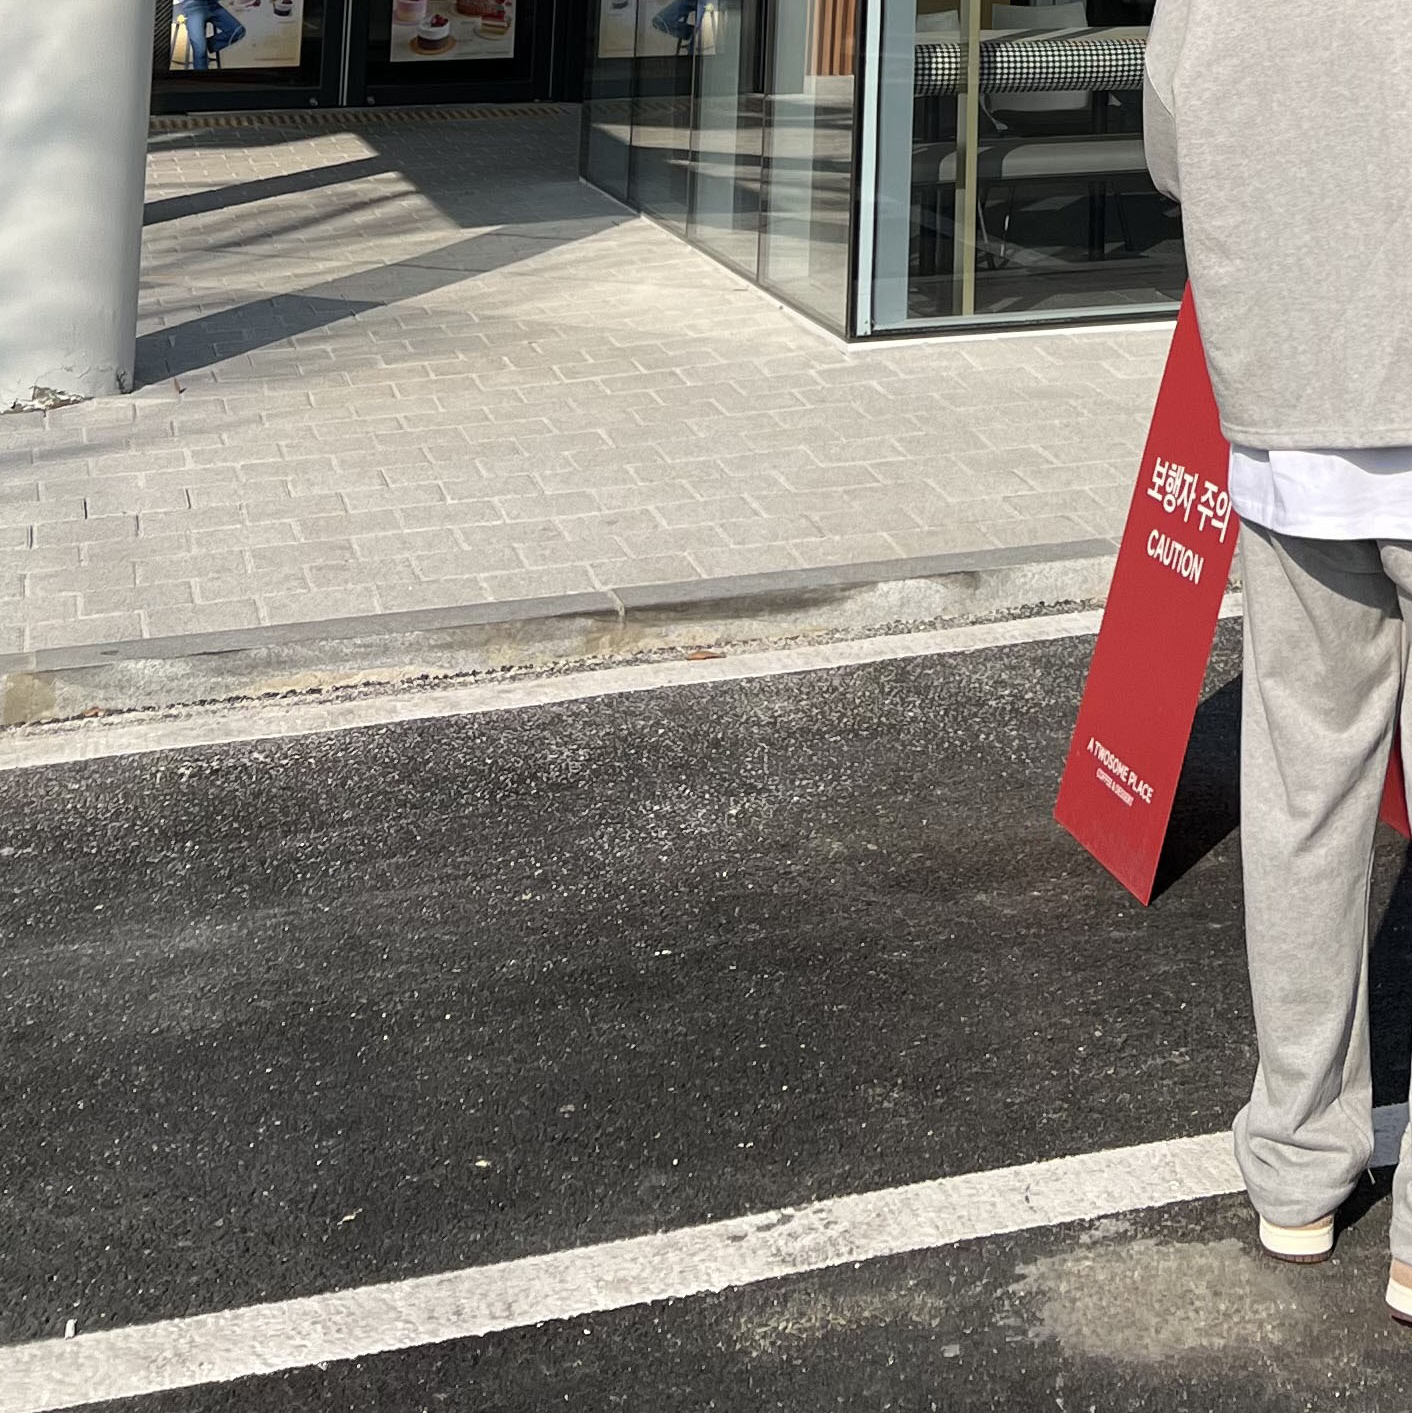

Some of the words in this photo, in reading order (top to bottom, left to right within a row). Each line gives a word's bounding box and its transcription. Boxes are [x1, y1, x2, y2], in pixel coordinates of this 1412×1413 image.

[1147, 457, 1199, 523] 보행자
[1197, 480, 1232, 543] 주의
[1147, 529, 1204, 585] CAUTION
[1086, 737, 1094, 753] A
[1094, 740, 1129, 782] TWOSOME
[1128, 771, 1154, 804] PLACE
